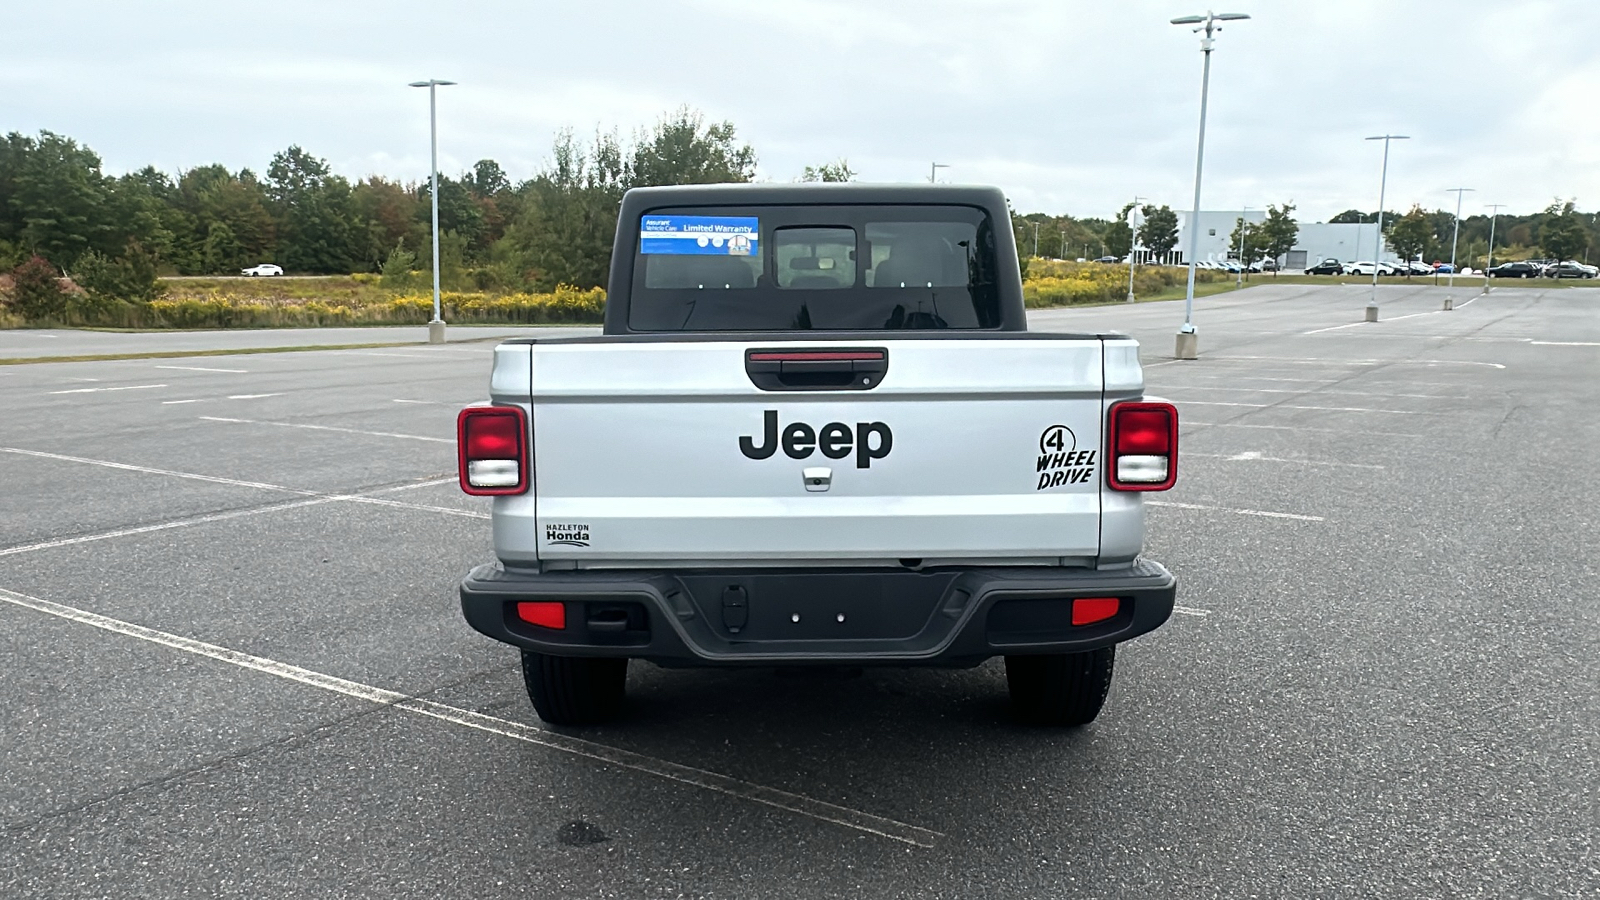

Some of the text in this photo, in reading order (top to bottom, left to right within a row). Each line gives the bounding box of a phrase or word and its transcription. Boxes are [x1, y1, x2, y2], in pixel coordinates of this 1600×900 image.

[683, 224, 752, 233] Limited Warranty
[739, 410, 893, 469] Jeep
[1046, 429, 1064, 451] 4
[1037, 450, 1096, 472] WHEEL
[1037, 468, 1094, 490] DRIVE
[547, 531, 589, 540] Honda
